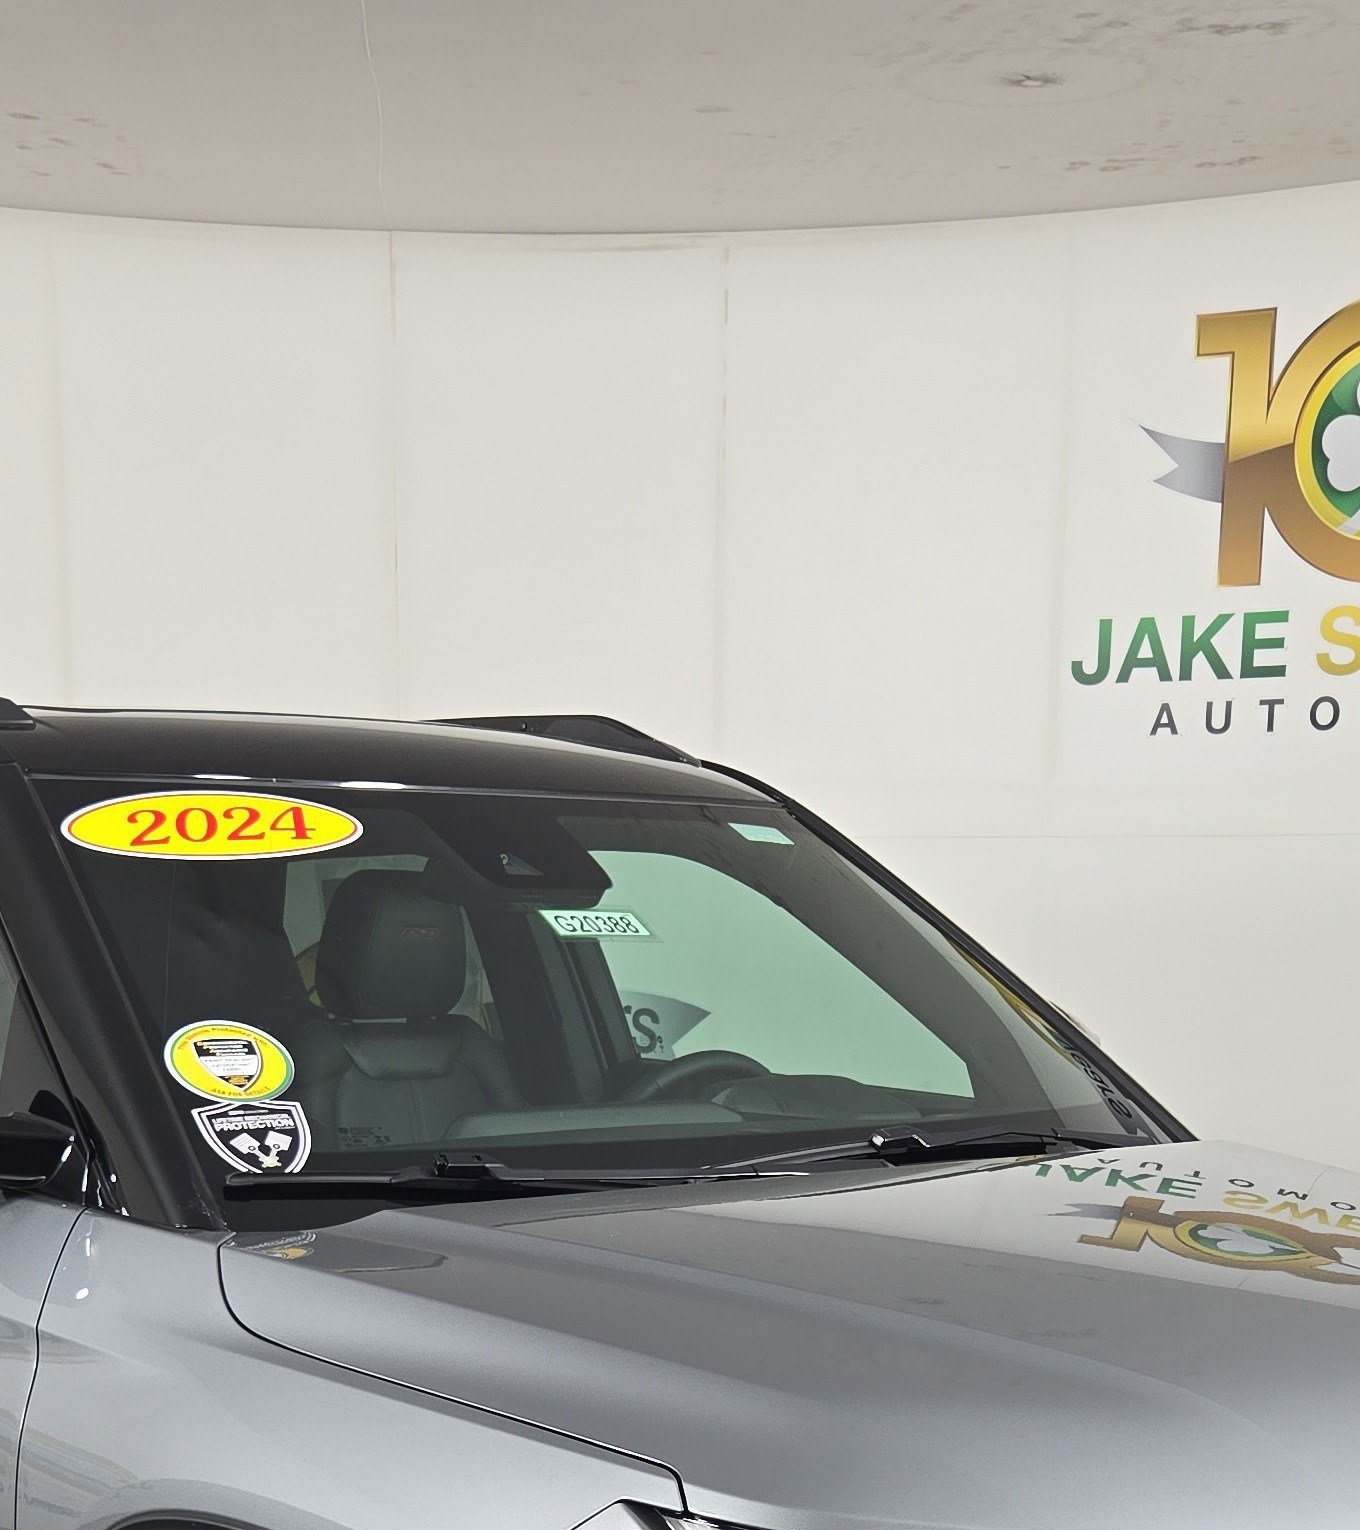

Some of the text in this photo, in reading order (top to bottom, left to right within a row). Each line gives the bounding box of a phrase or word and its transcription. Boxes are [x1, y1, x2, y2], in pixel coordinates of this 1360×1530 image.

[1071, 610, 1290, 686] JAKE
[127, 806, 317, 847] 2024
[554, 915, 640, 934] G20388
[213, 1119, 295, 1132] PROTECTION
